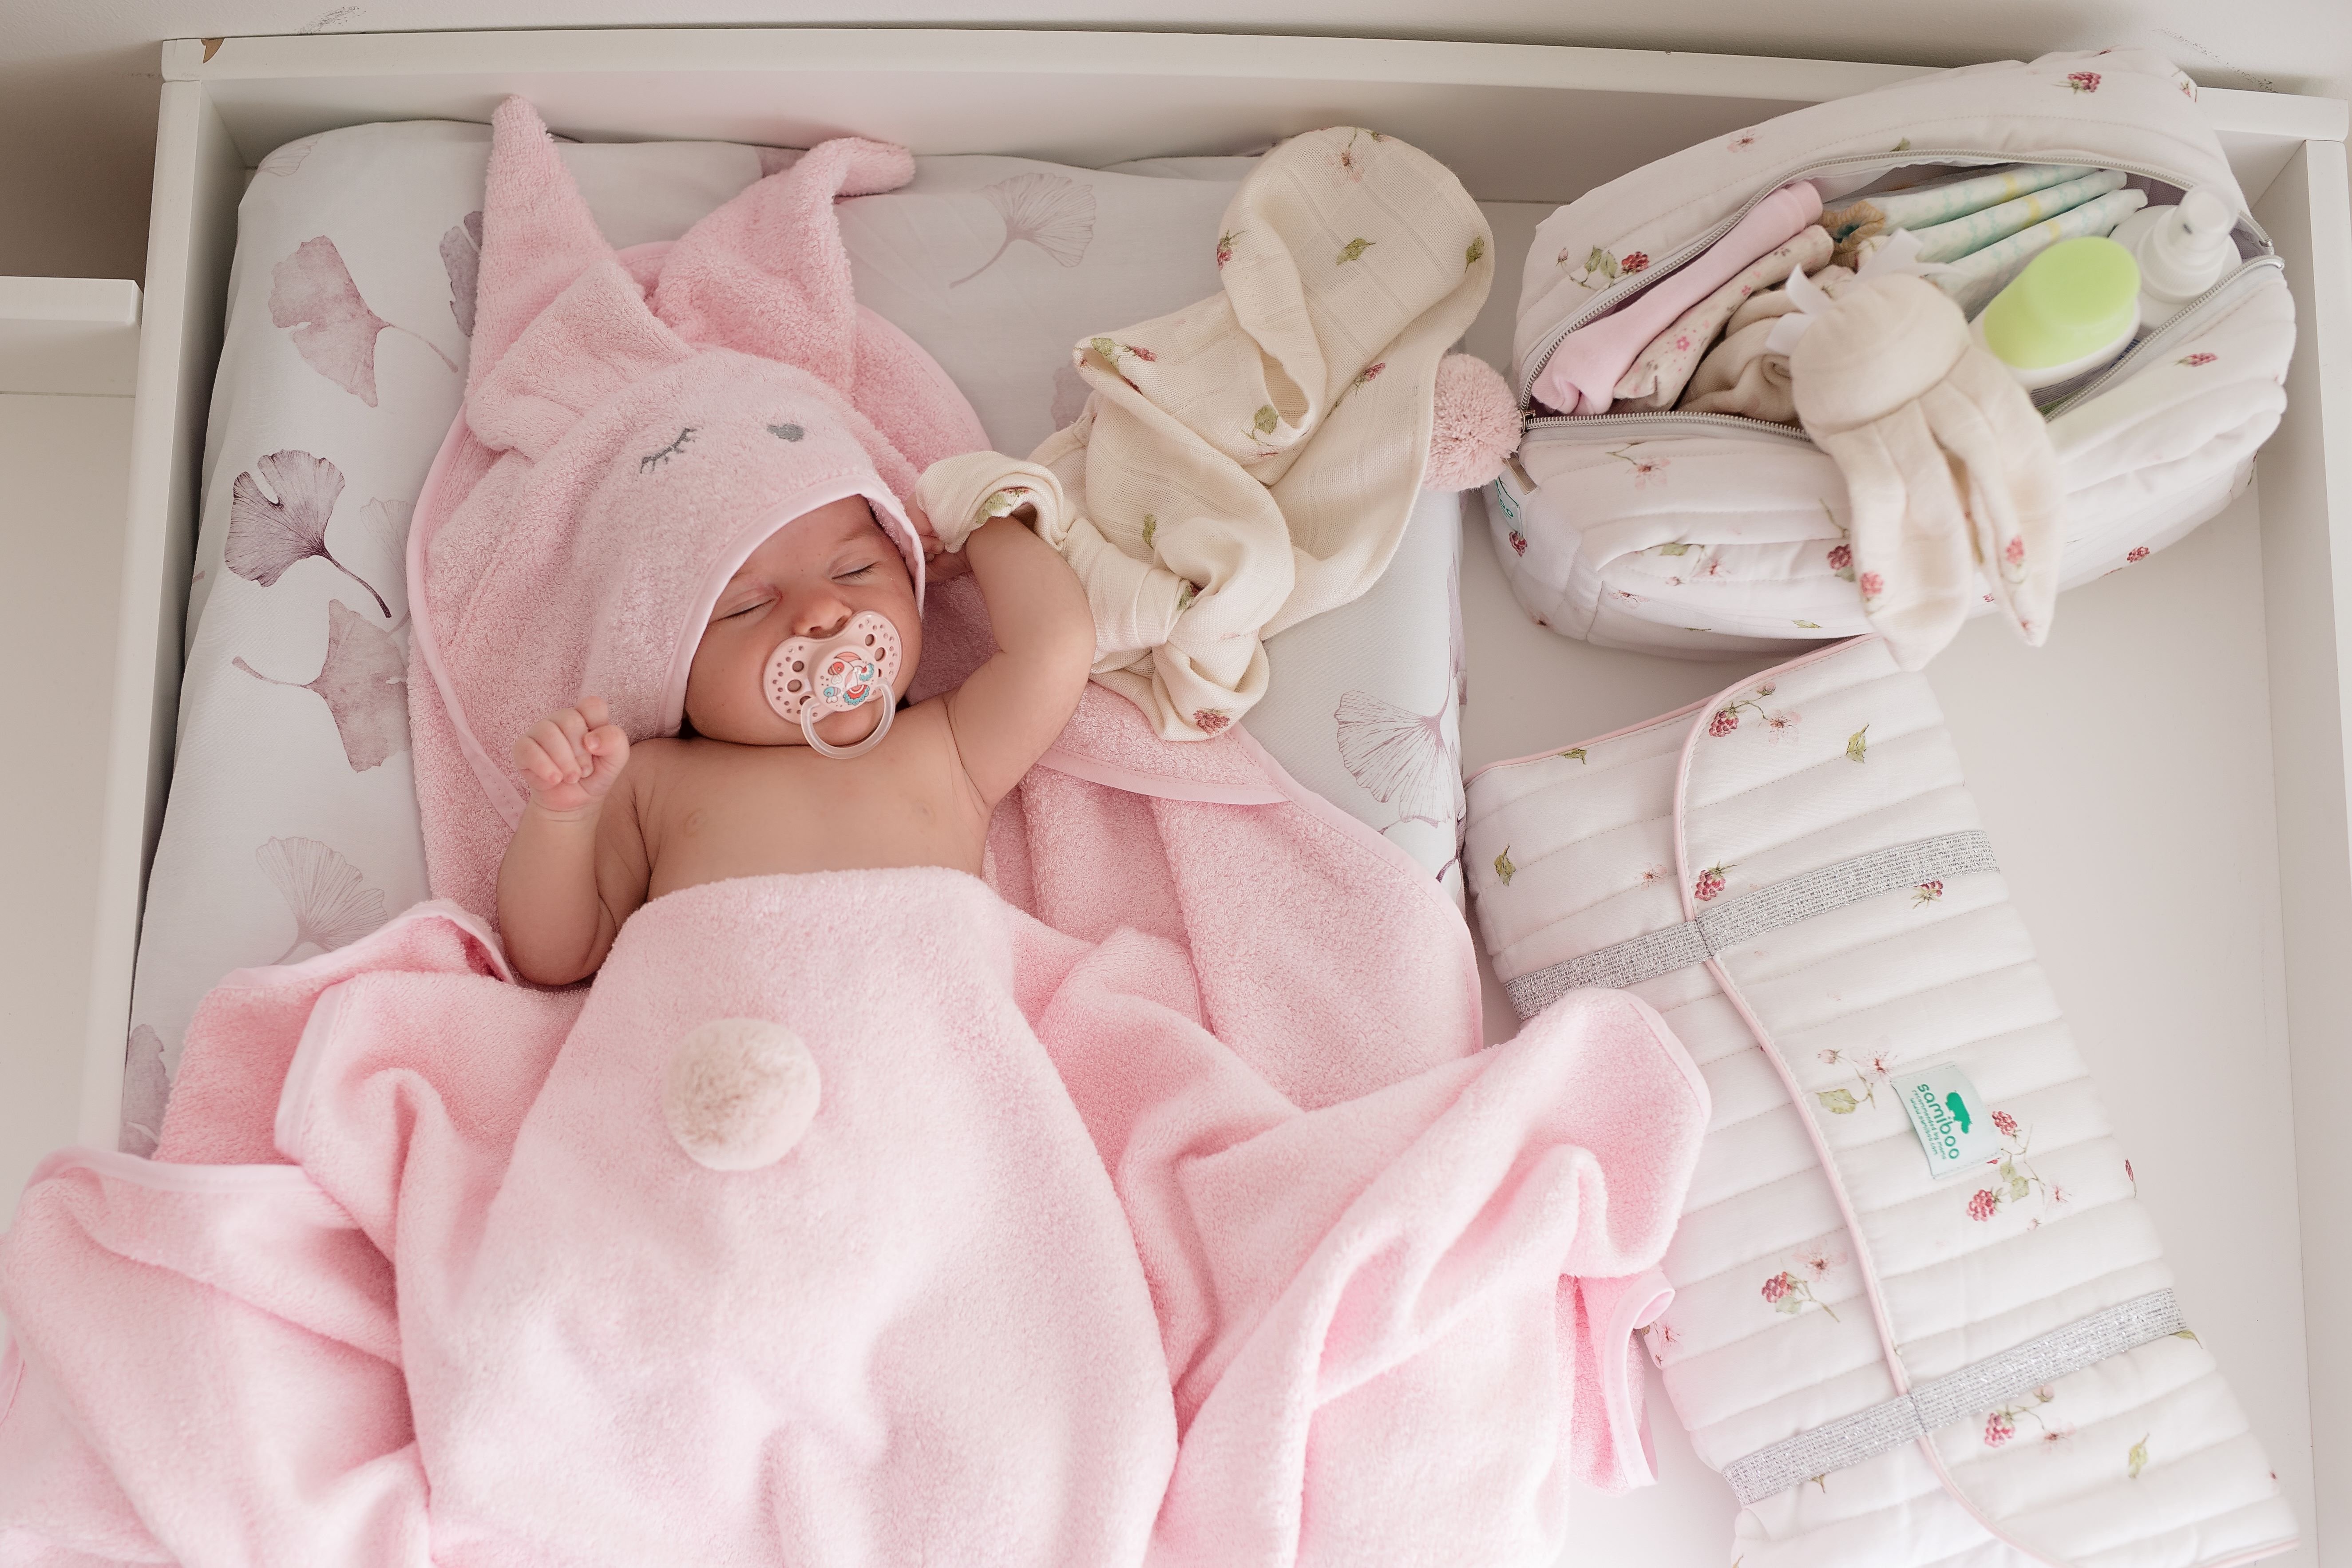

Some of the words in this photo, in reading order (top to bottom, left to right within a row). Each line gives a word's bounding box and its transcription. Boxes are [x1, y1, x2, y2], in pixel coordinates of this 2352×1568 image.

[1912, 1090, 1936, 1130] recommended
[1933, 1132, 1939, 1140] by
[1917, 1084, 1959, 1159] samiboo
